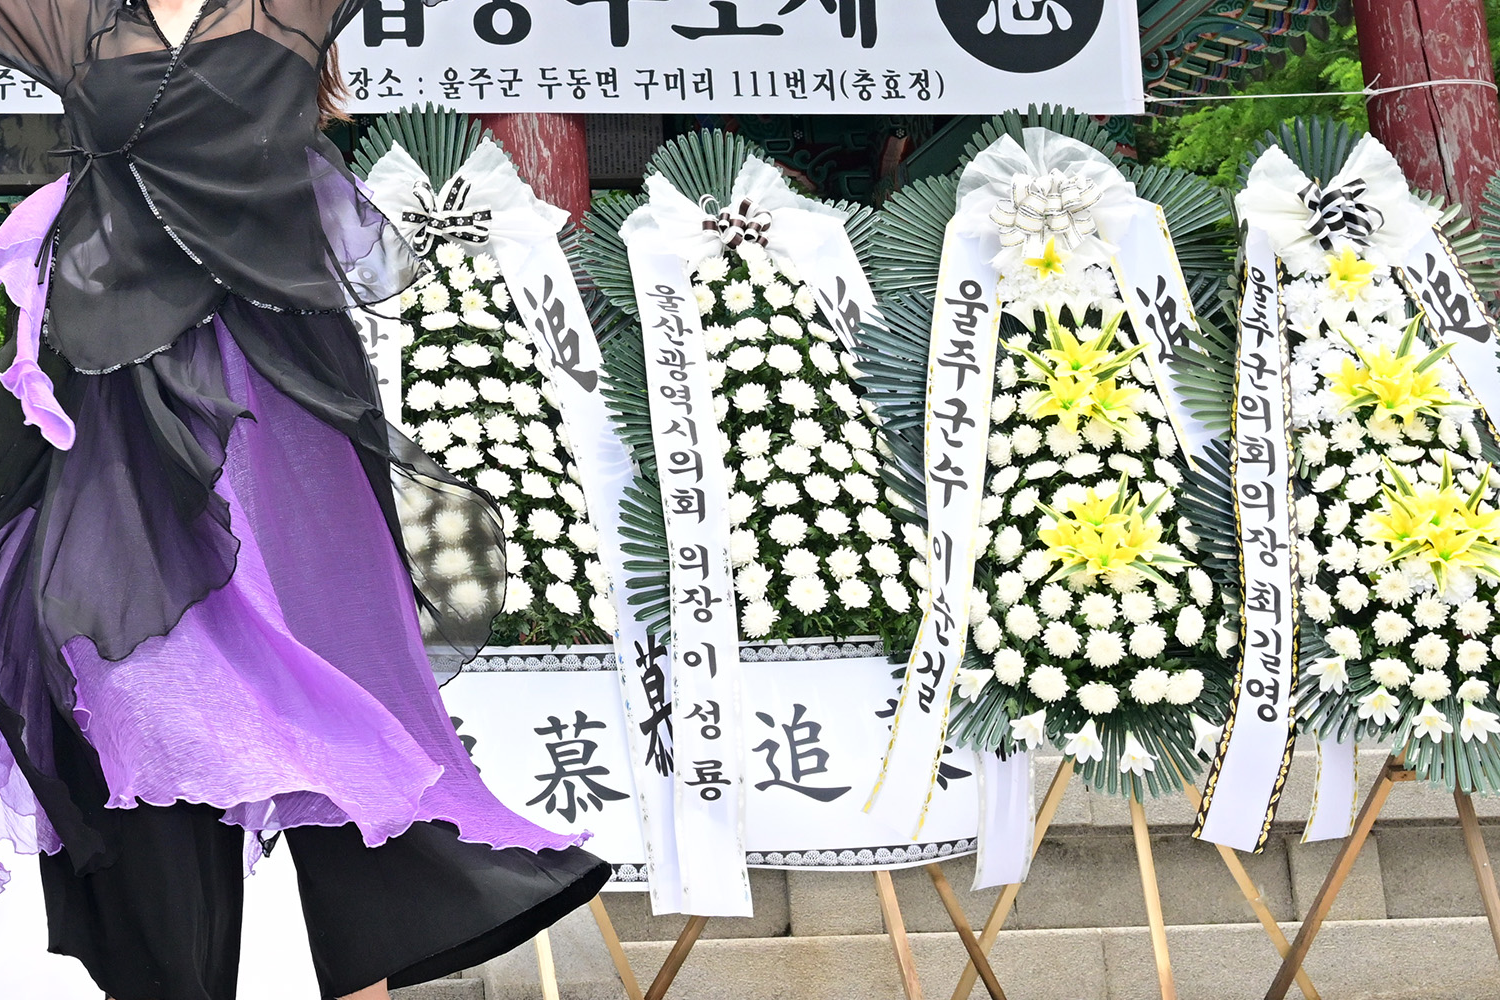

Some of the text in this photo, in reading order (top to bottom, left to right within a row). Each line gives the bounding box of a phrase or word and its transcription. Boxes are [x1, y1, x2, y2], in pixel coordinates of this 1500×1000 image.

[349, 67, 404, 100] 장소
[439, 67, 523, 99] 울주군
[538, 67, 619, 99] 두동면
[634, 67, 714, 100] 구미리
[733, 68, 945, 101] 111번지(충효정)
[523, 275, 597, 392] 追
[930, 280, 988, 508] 울주군수
[646, 285, 706, 524] 울산광역시의회
[678, 544, 723, 623] 의장
